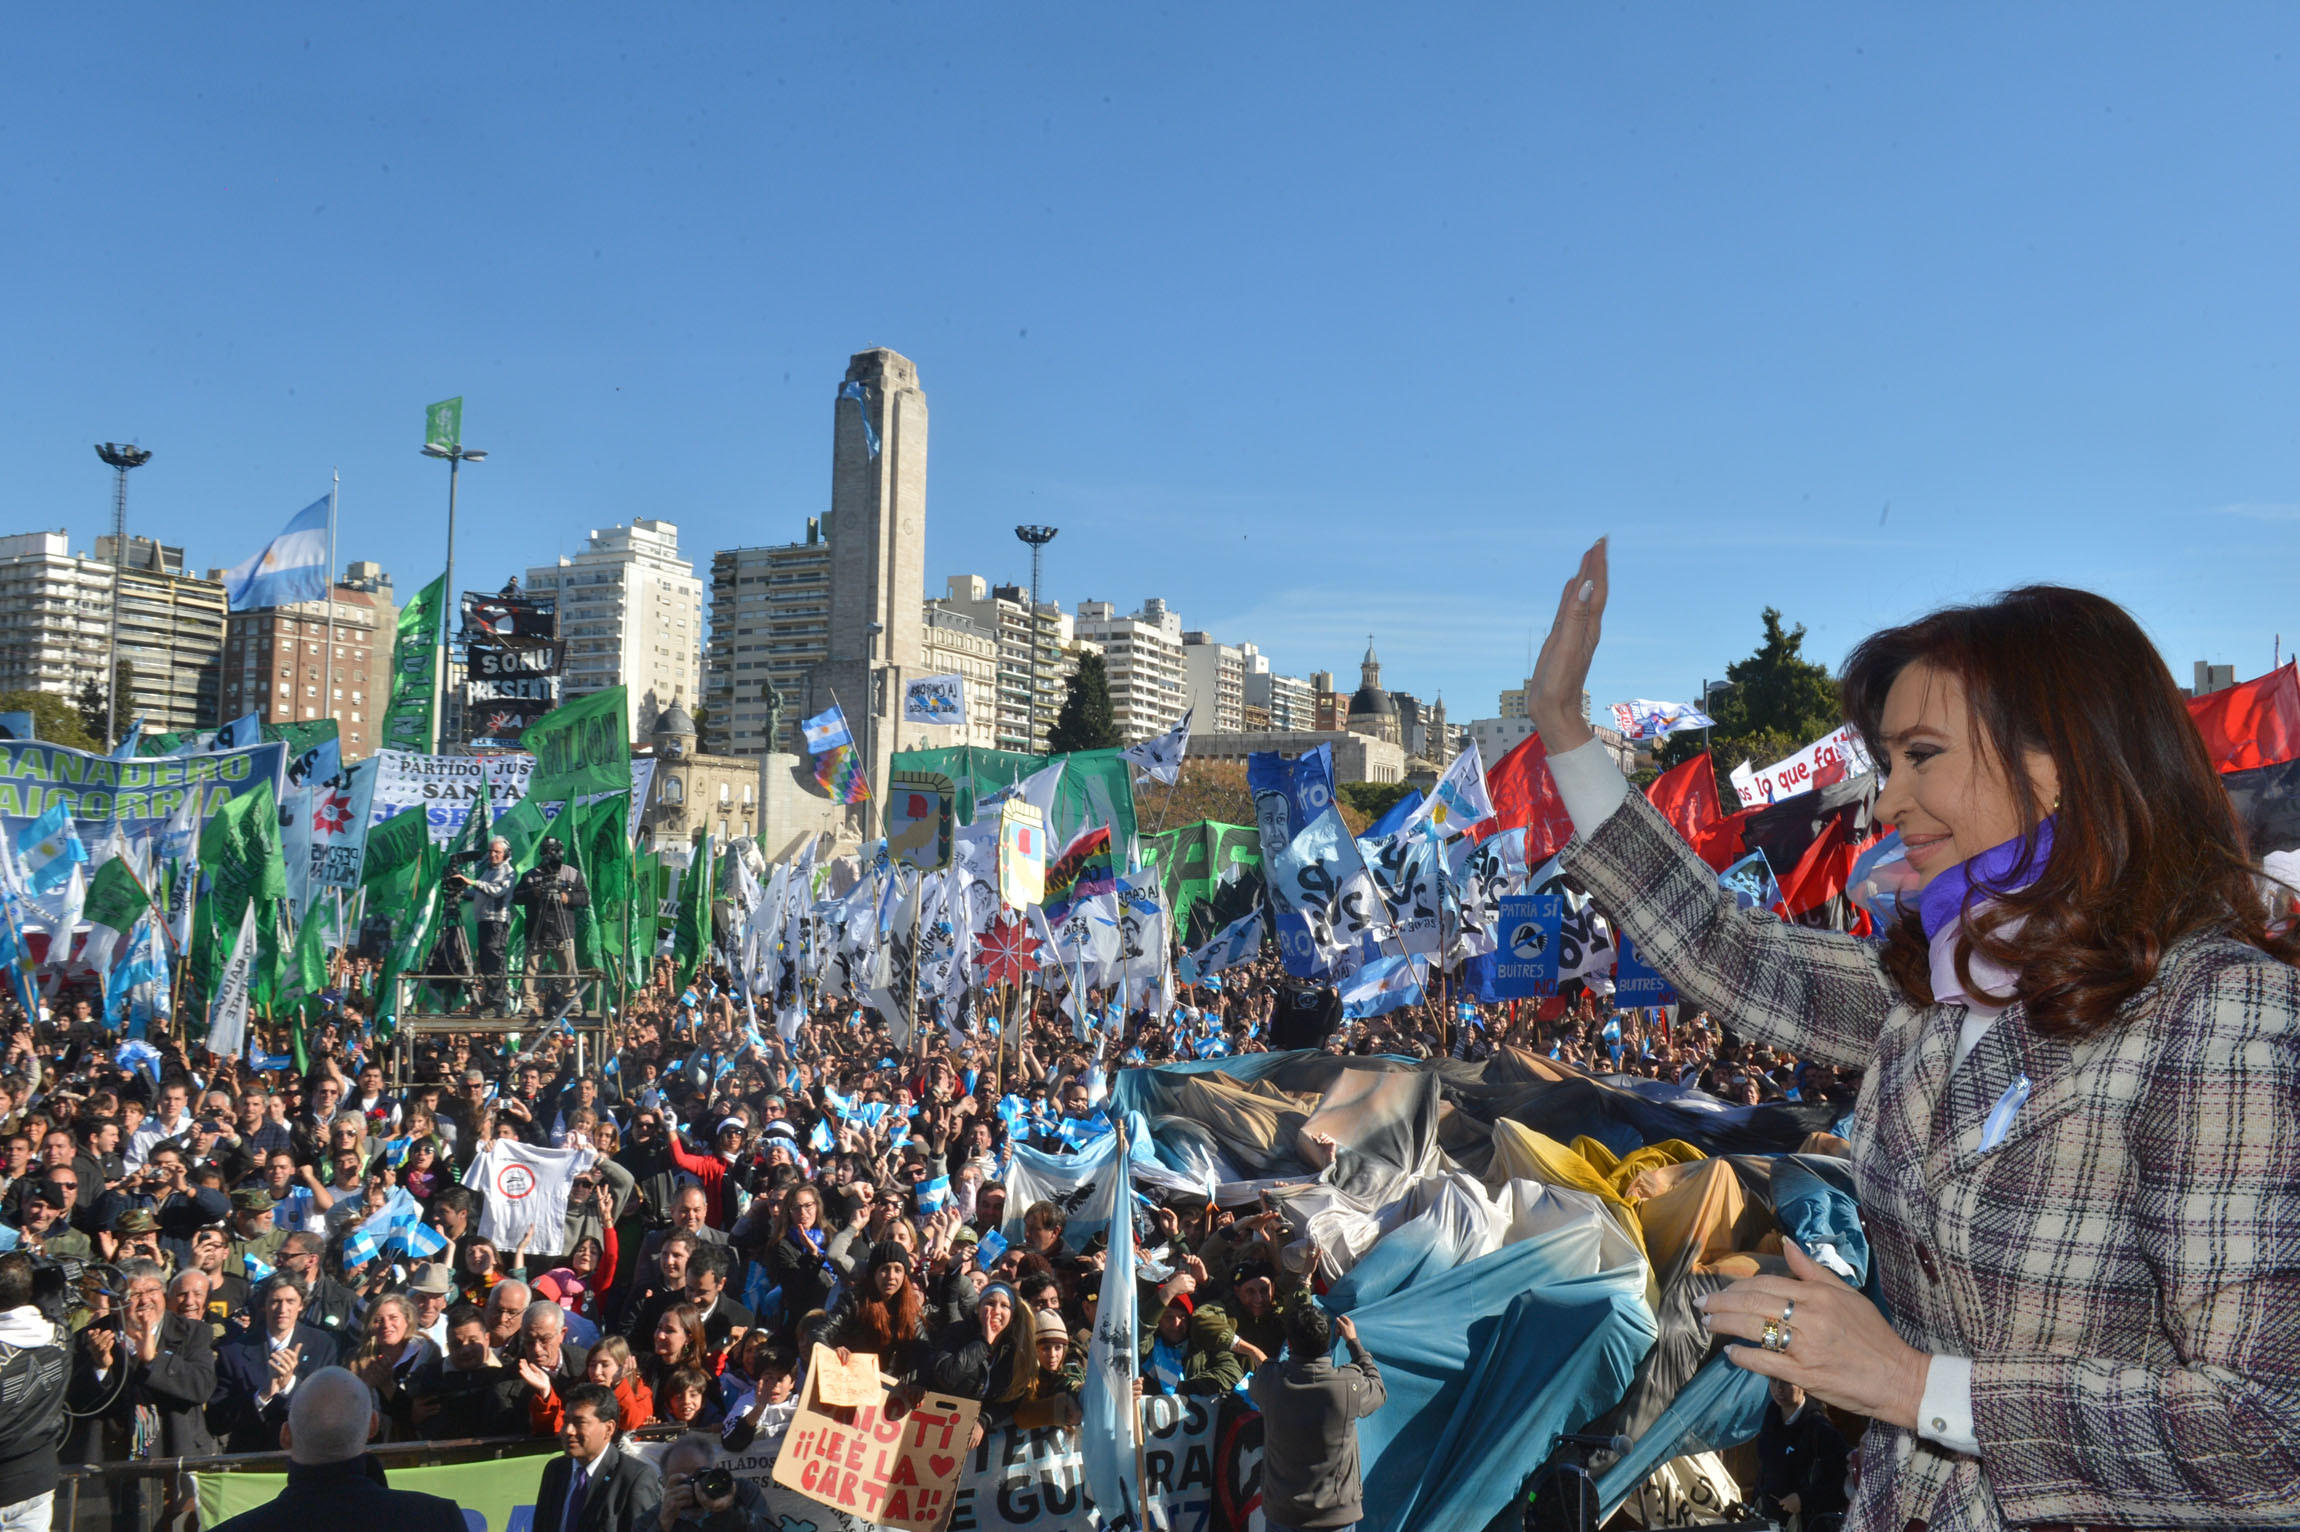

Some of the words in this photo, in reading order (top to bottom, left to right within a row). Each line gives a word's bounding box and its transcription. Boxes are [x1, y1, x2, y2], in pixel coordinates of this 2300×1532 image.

[401, 760, 481, 777] PARTIDO
[495, 763, 534, 776] JUS
[1754, 776, 1773, 797] lo
[1778, 762, 1810, 792] que
[1533, 978, 1556, 996] NO
[1619, 978, 1665, 992] BUITRES
[873, 1450, 919, 1487] LA
